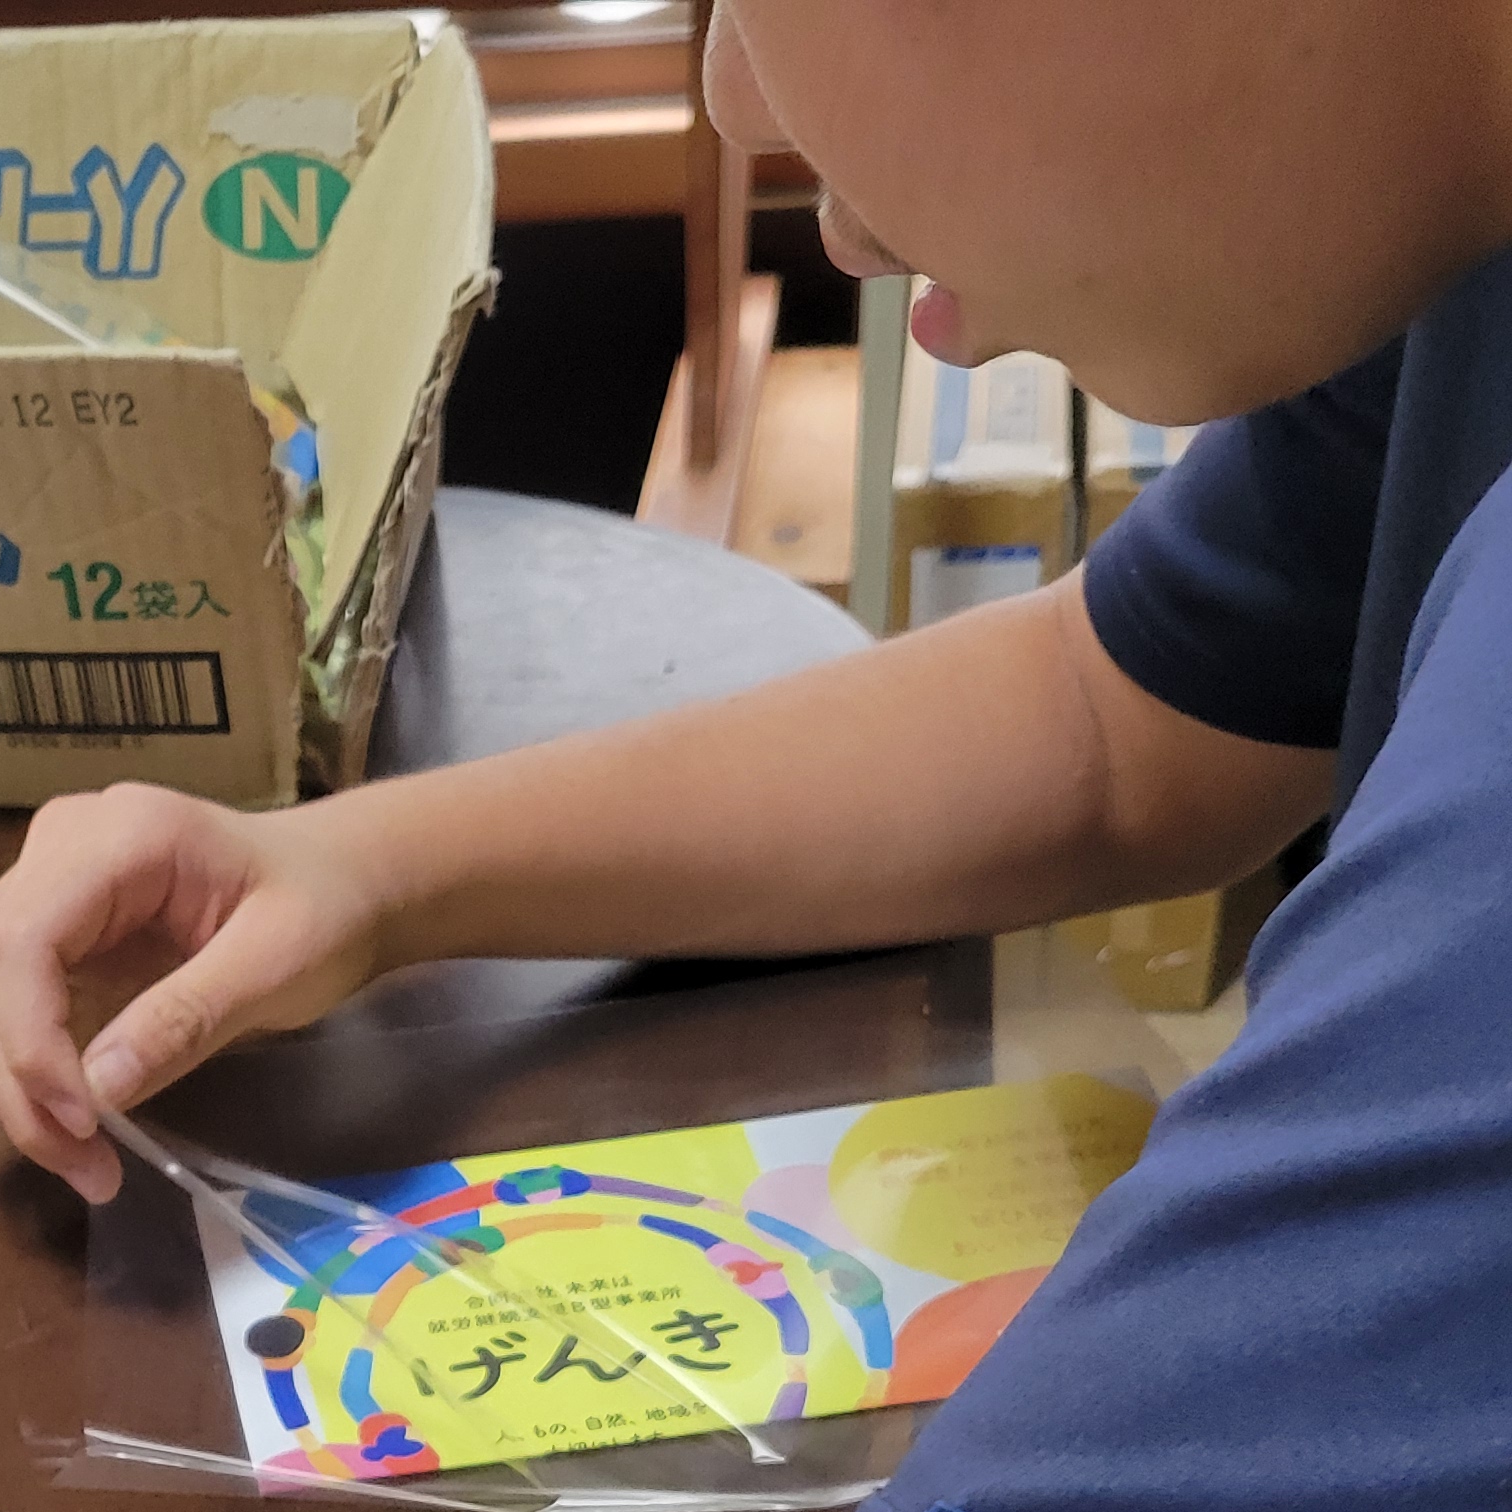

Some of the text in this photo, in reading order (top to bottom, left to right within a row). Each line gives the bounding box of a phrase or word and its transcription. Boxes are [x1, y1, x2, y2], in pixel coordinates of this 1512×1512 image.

[73, 393, 138, 428] EY2
[410, 1308, 738, 1402] げんき
